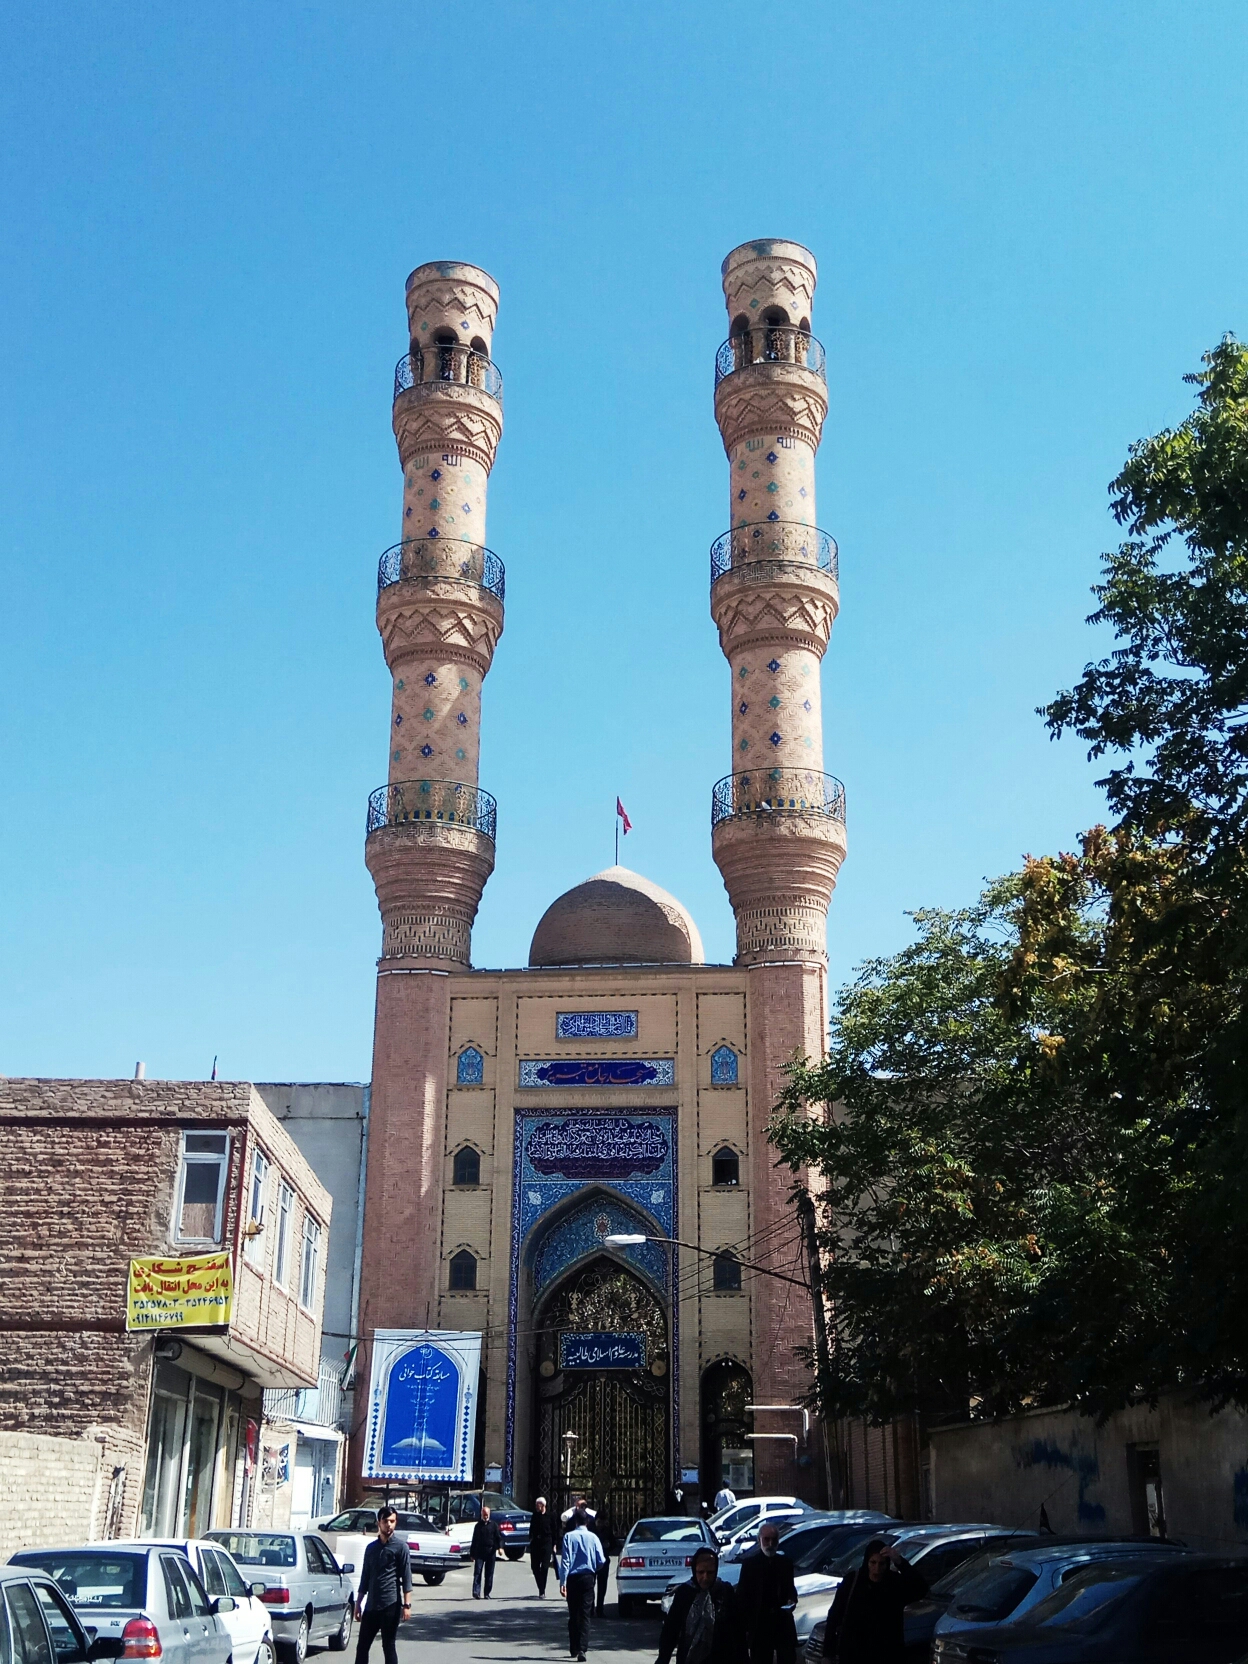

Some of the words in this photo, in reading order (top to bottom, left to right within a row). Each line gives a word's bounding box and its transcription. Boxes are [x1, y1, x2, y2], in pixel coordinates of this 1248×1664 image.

[585, 1063, 608, 1084] جامع
[608, 1064, 654, 1084] مسجد
[133, 1262, 183, 1278] شکاری
[186, 1256, 229, 1275] اسفنج
[134, 1280, 154, 1296] یافت
[156, 1279, 180, 1295] انتقال
[183, 1279, 202, 1294] محل
[205, 1277, 218, 1292] این
[221, 1278, 229, 1291] به
[399, 1363, 415, 1381] خوانی
[414, 1361, 442, 1383] کتاب
[433, 1369, 450, 1383] مسابقه
